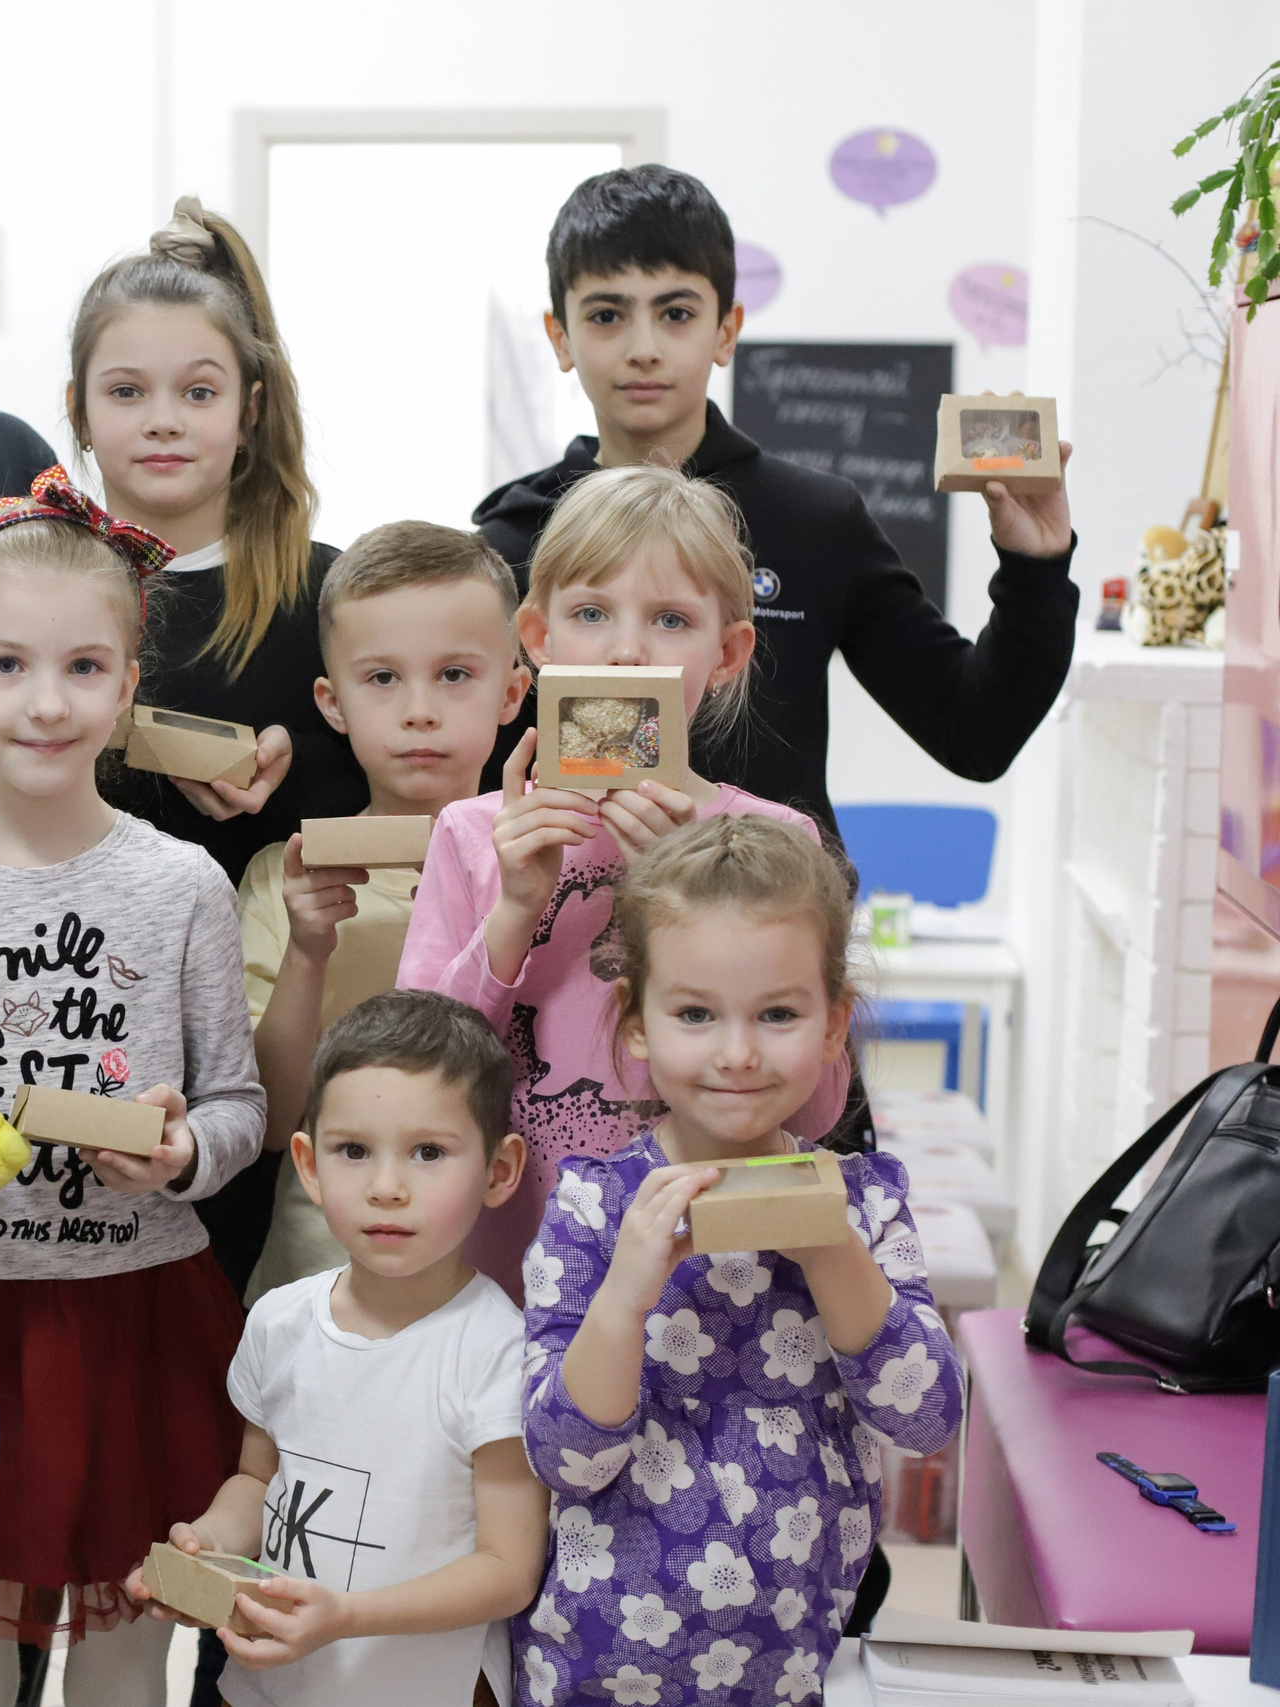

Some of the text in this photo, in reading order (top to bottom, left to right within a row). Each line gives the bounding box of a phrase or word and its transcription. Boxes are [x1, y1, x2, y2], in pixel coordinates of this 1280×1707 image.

[753, 606, 805, 621] Motorsport
[49, 986, 129, 1042] the
[10, 1218, 52, 1243] THIS
[57, 1216, 107, 1245] DRESS
[108, 1210, 140, 1243] TOO)
[1073, 1652, 1100, 1686] ебенком
